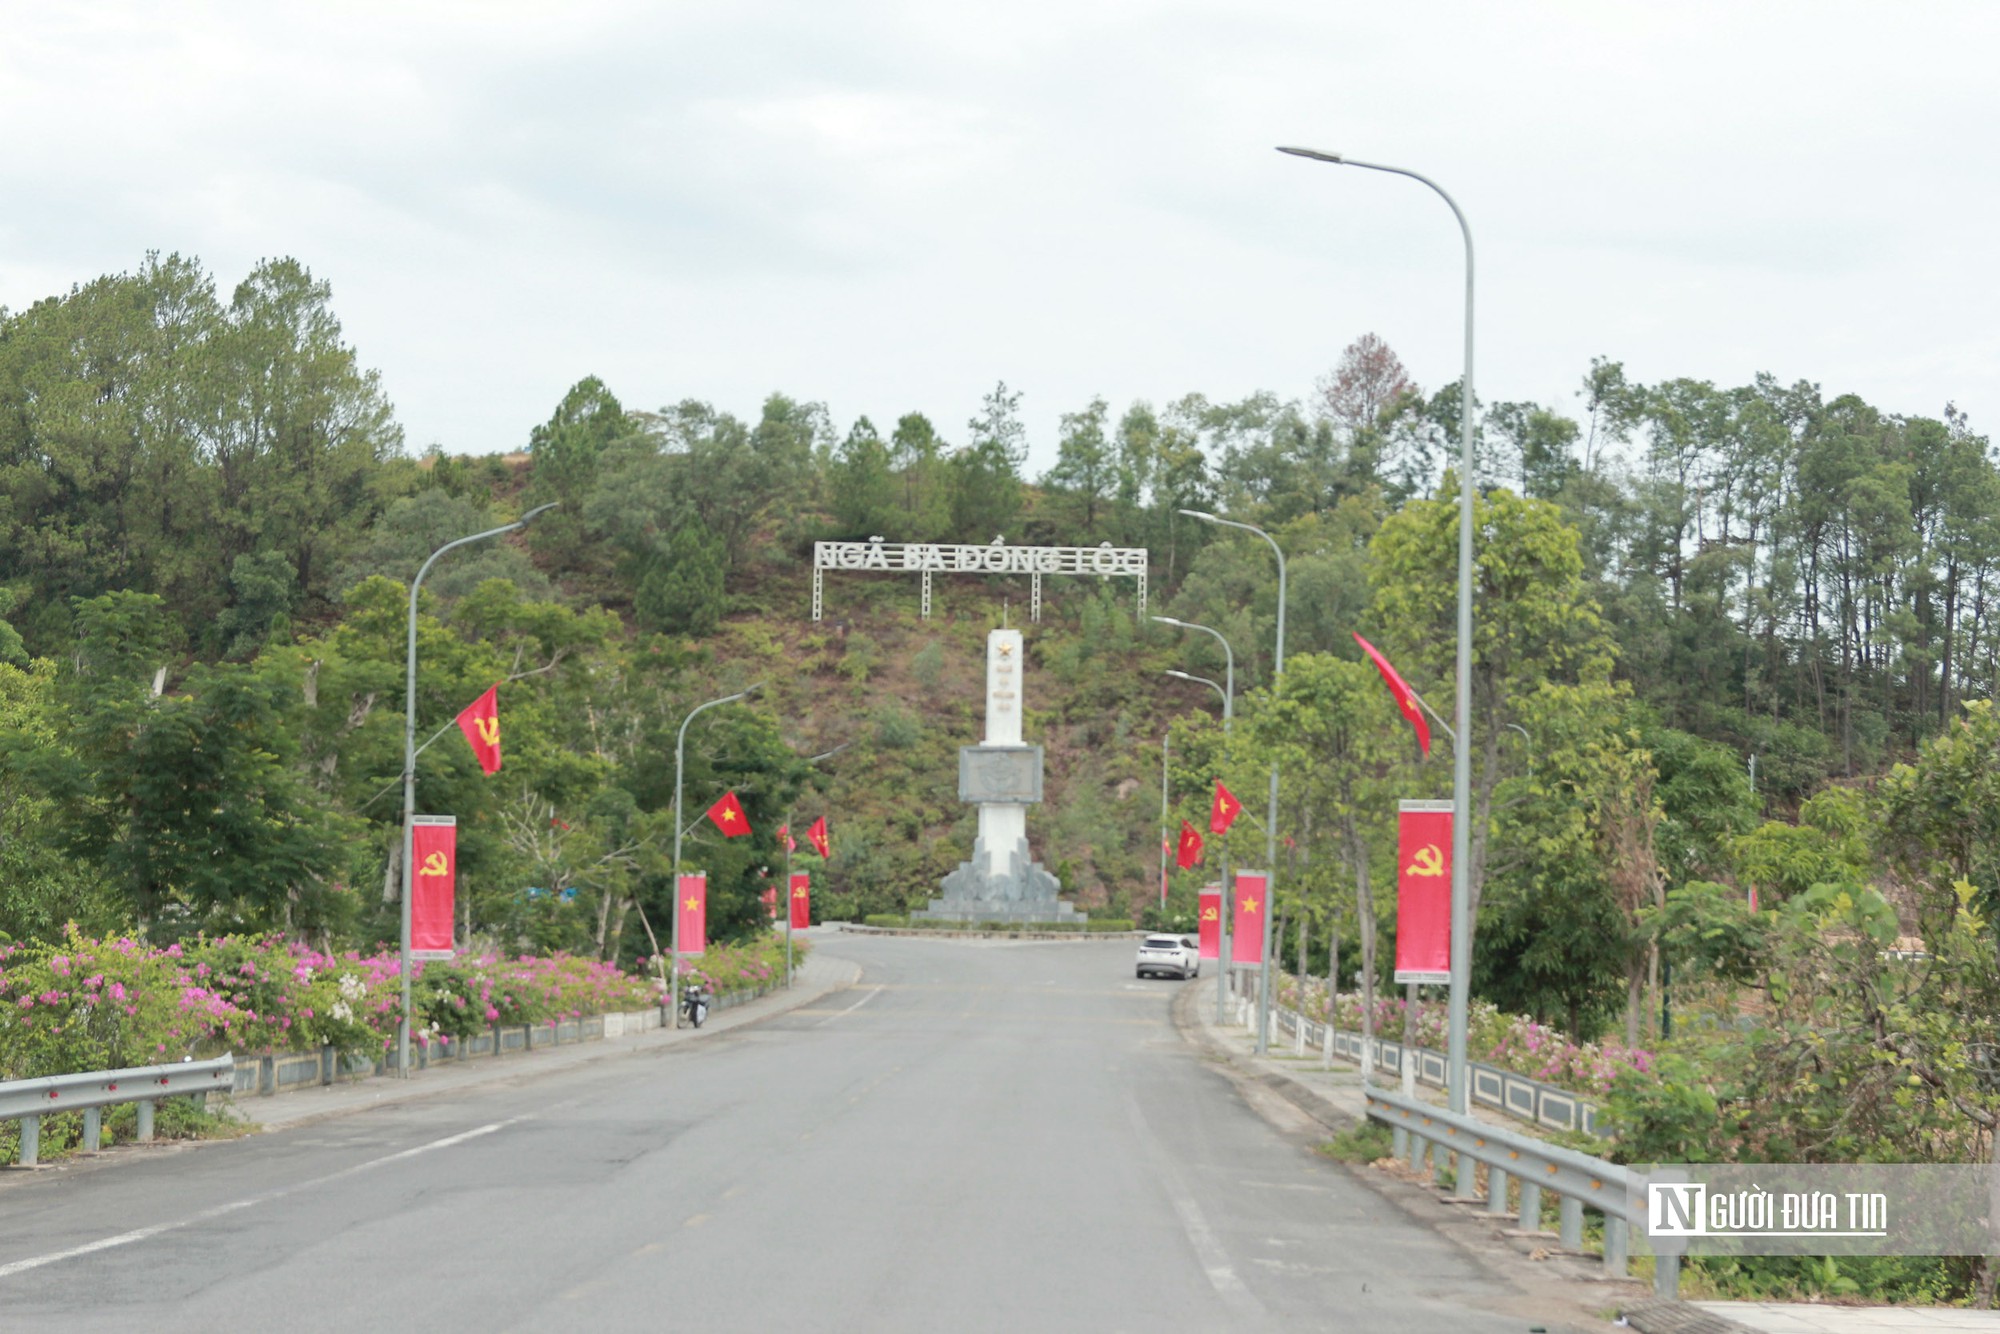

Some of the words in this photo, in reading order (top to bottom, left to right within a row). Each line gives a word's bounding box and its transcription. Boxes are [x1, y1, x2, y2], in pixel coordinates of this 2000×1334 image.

[815, 535, 889, 569] NGÃ
[903, 544, 946, 570] BA
[955, 533, 1062, 573] ĐỒNG
[1076, 541, 1146, 581] LỘC
